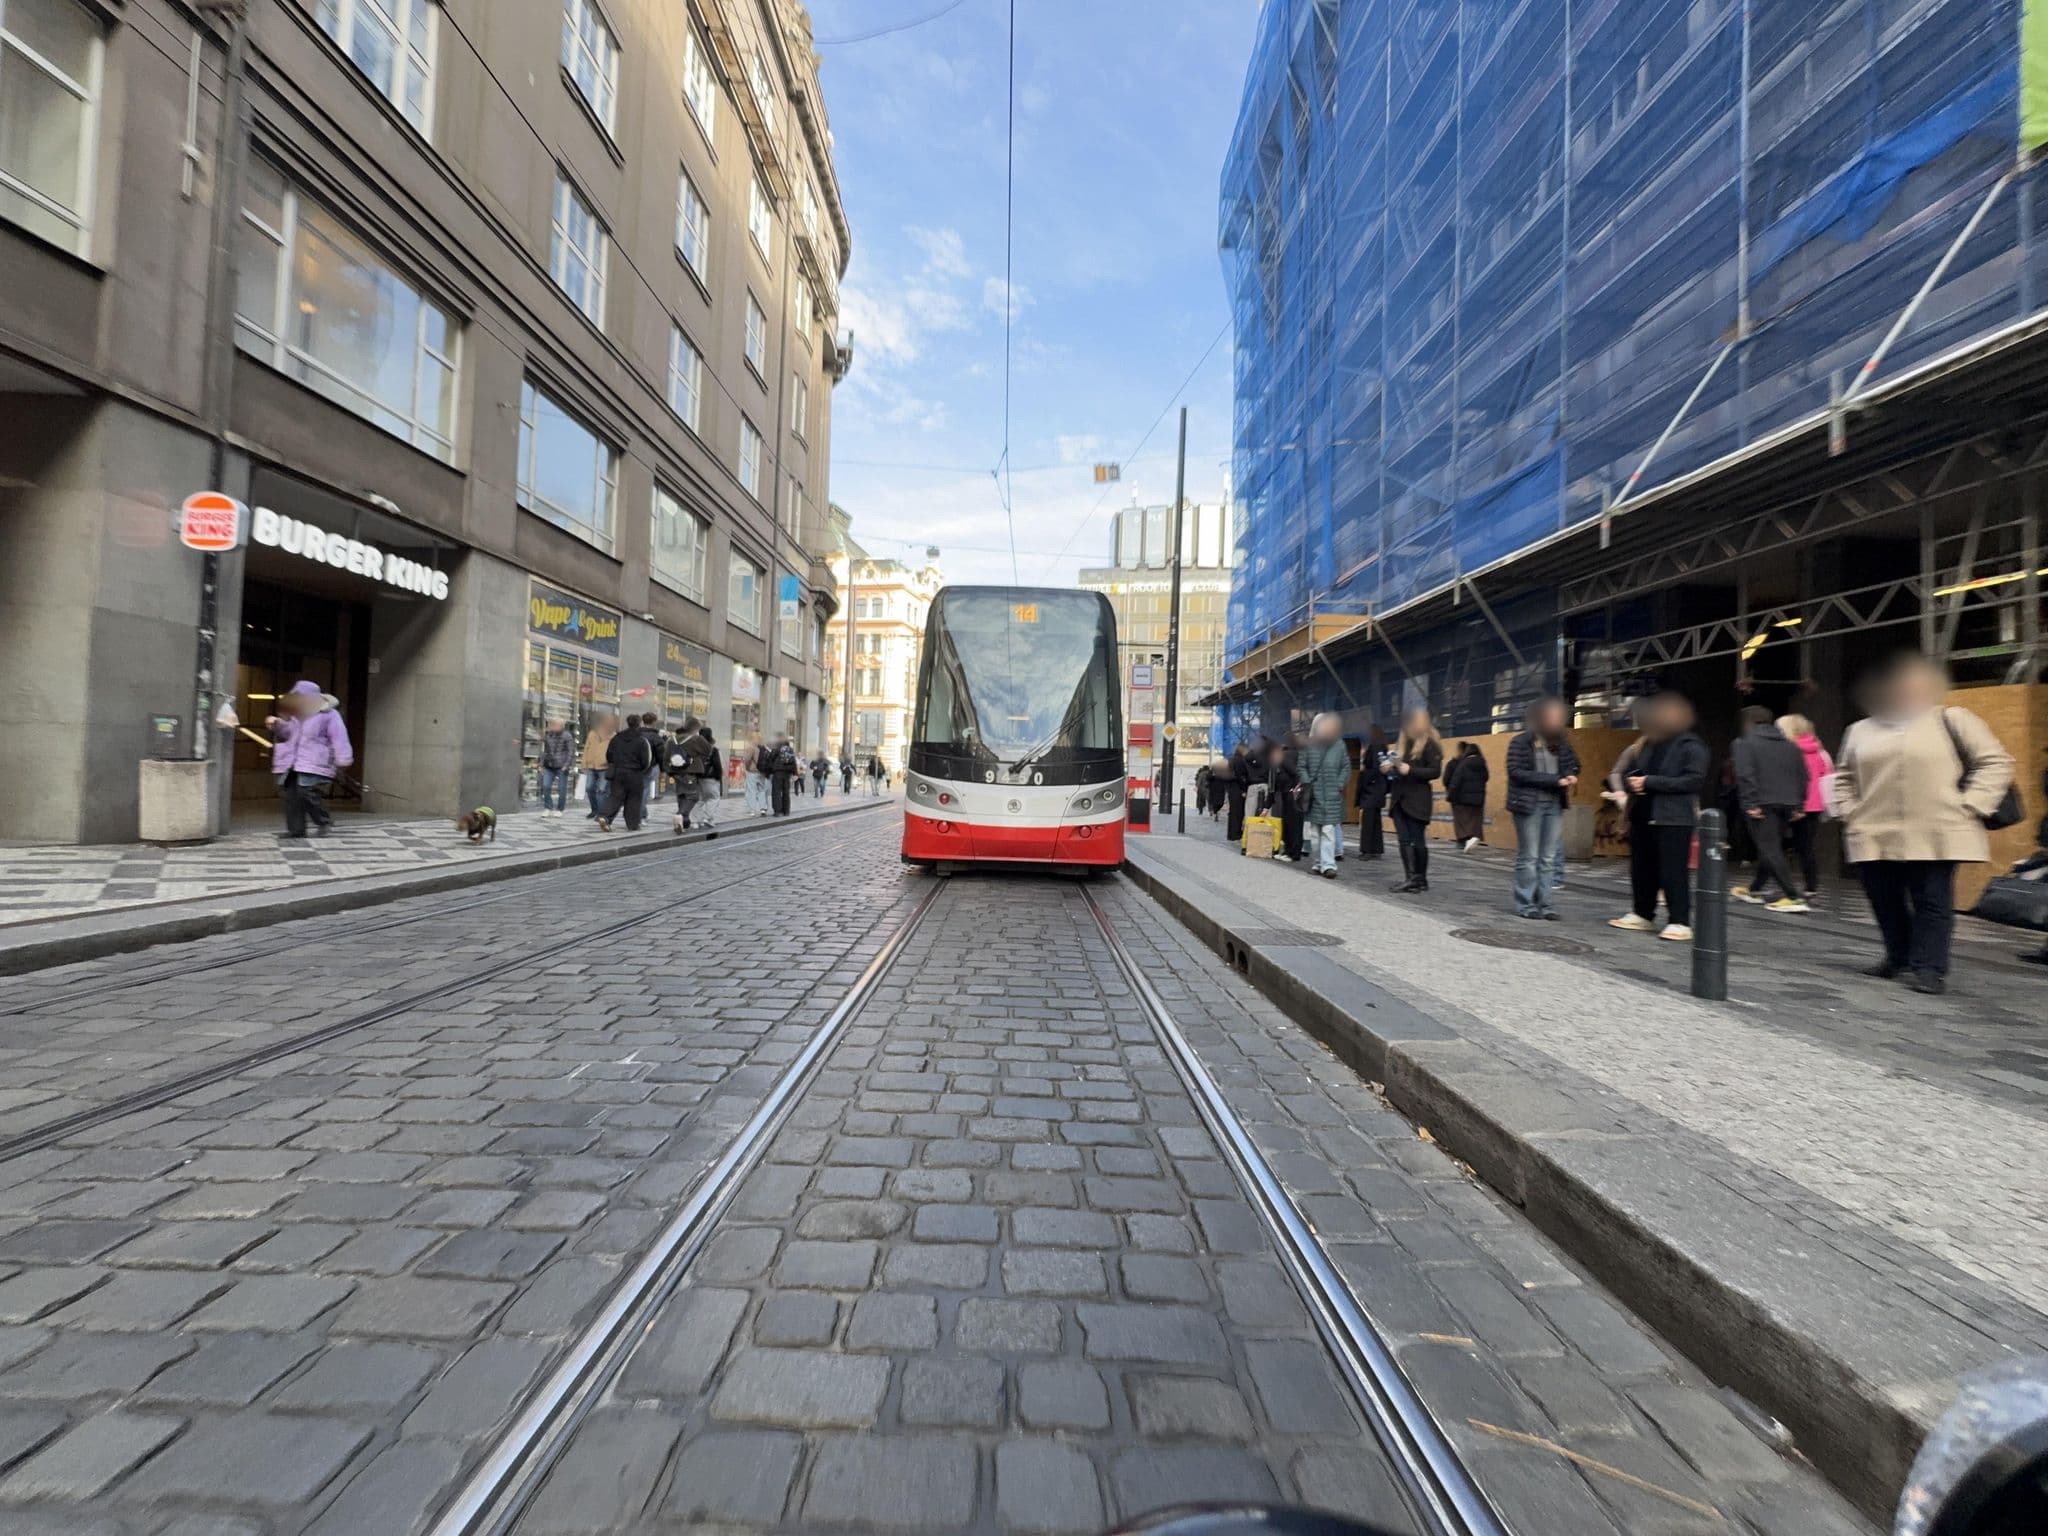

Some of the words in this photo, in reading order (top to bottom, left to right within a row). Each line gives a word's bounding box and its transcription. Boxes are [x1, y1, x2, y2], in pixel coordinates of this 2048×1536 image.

[187, 524, 233, 536] KING
[253, 506, 383, 581] BURGER
[384, 554, 449, 600] KING
[531, 598, 571, 630] Vape
[585, 616, 617, 640] Drink
[1013, 603, 1037, 624] 14
